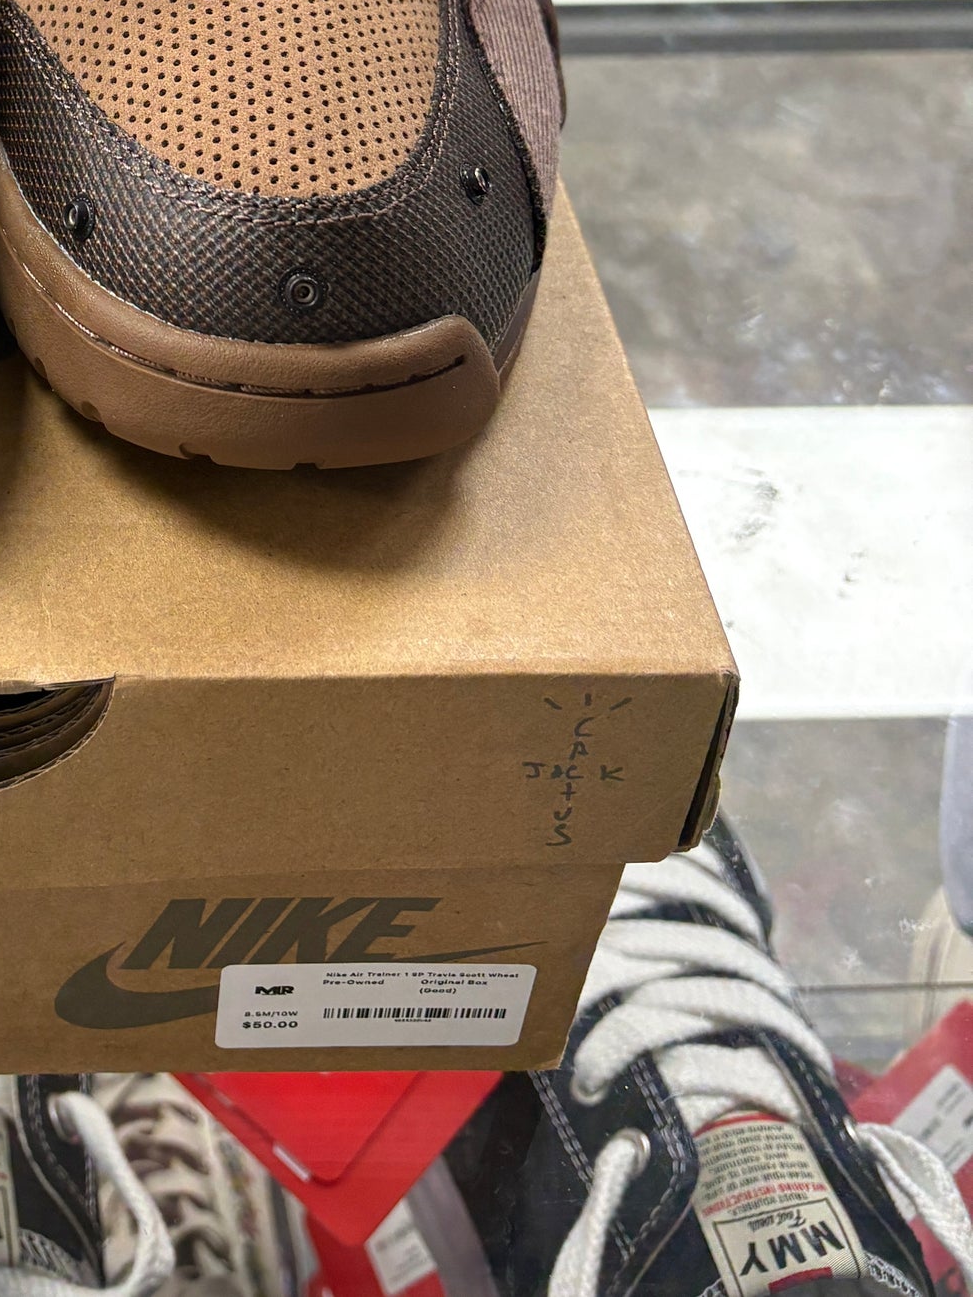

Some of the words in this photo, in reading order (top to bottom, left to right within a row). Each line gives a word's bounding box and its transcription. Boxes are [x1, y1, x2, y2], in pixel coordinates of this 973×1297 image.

[118, 897, 442, 969] NIKE
[242, 1020, 298, 1029] $50.00
[739, 1221, 844, 1277] MMY
